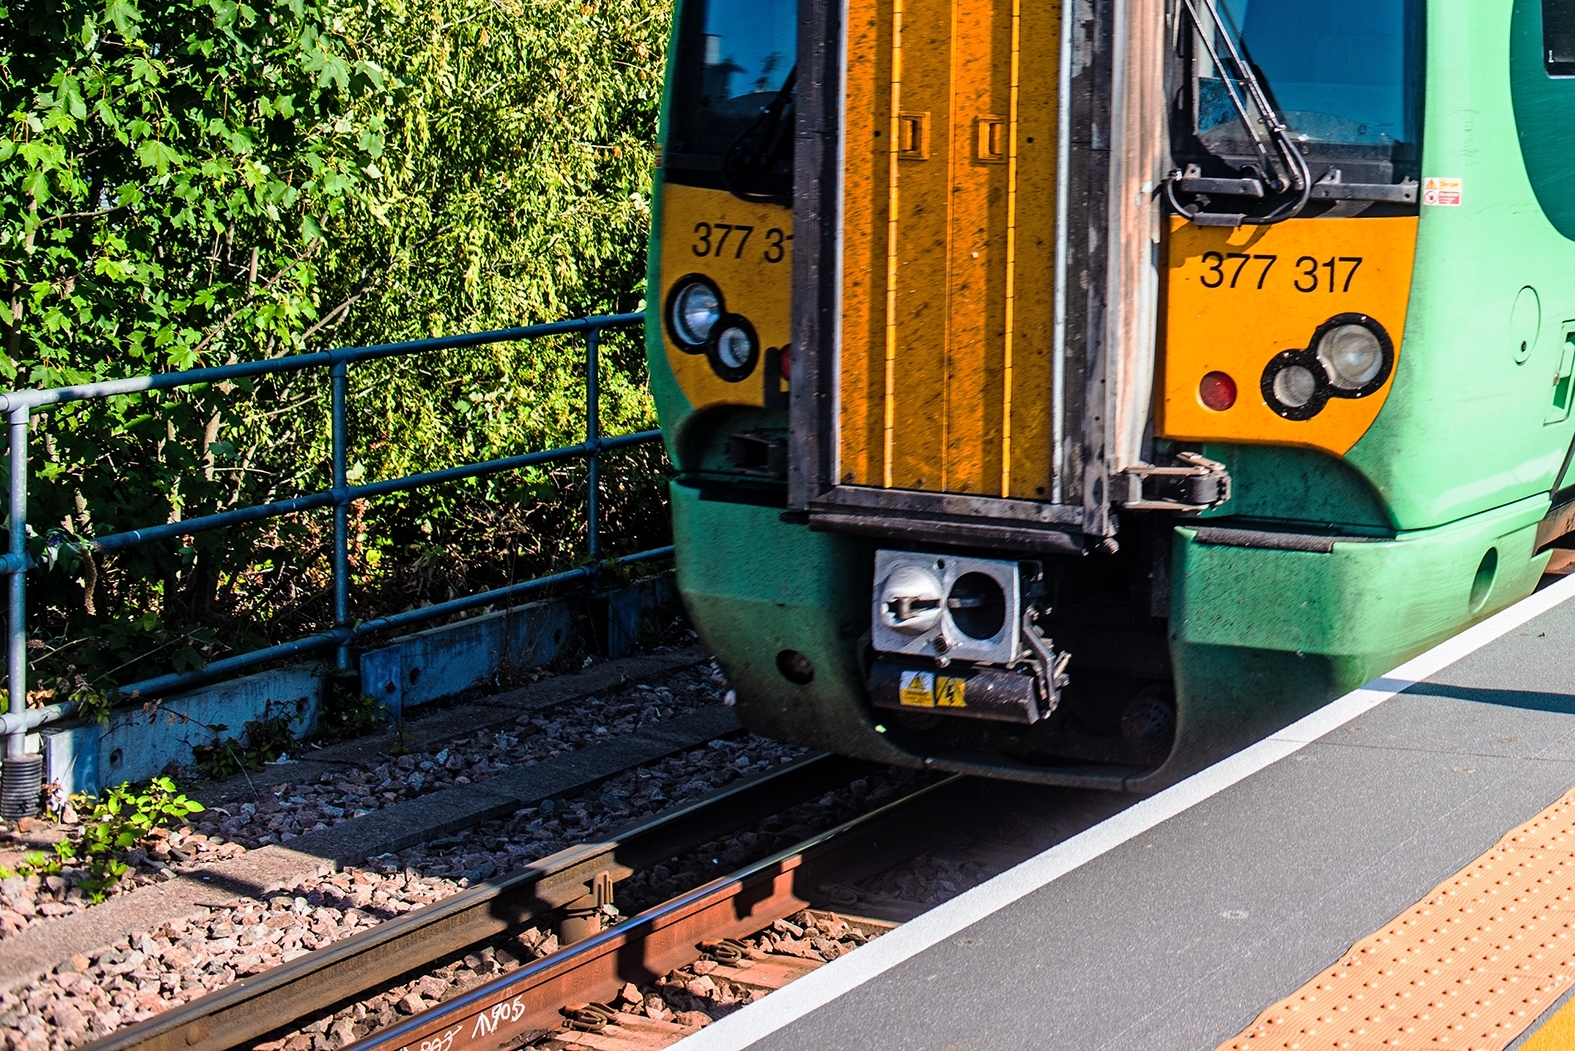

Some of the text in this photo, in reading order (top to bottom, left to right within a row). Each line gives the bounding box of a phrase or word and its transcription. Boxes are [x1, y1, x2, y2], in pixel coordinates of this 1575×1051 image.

[691, 222, 754, 259] 377
[1200, 251, 1363, 293] 377 317
